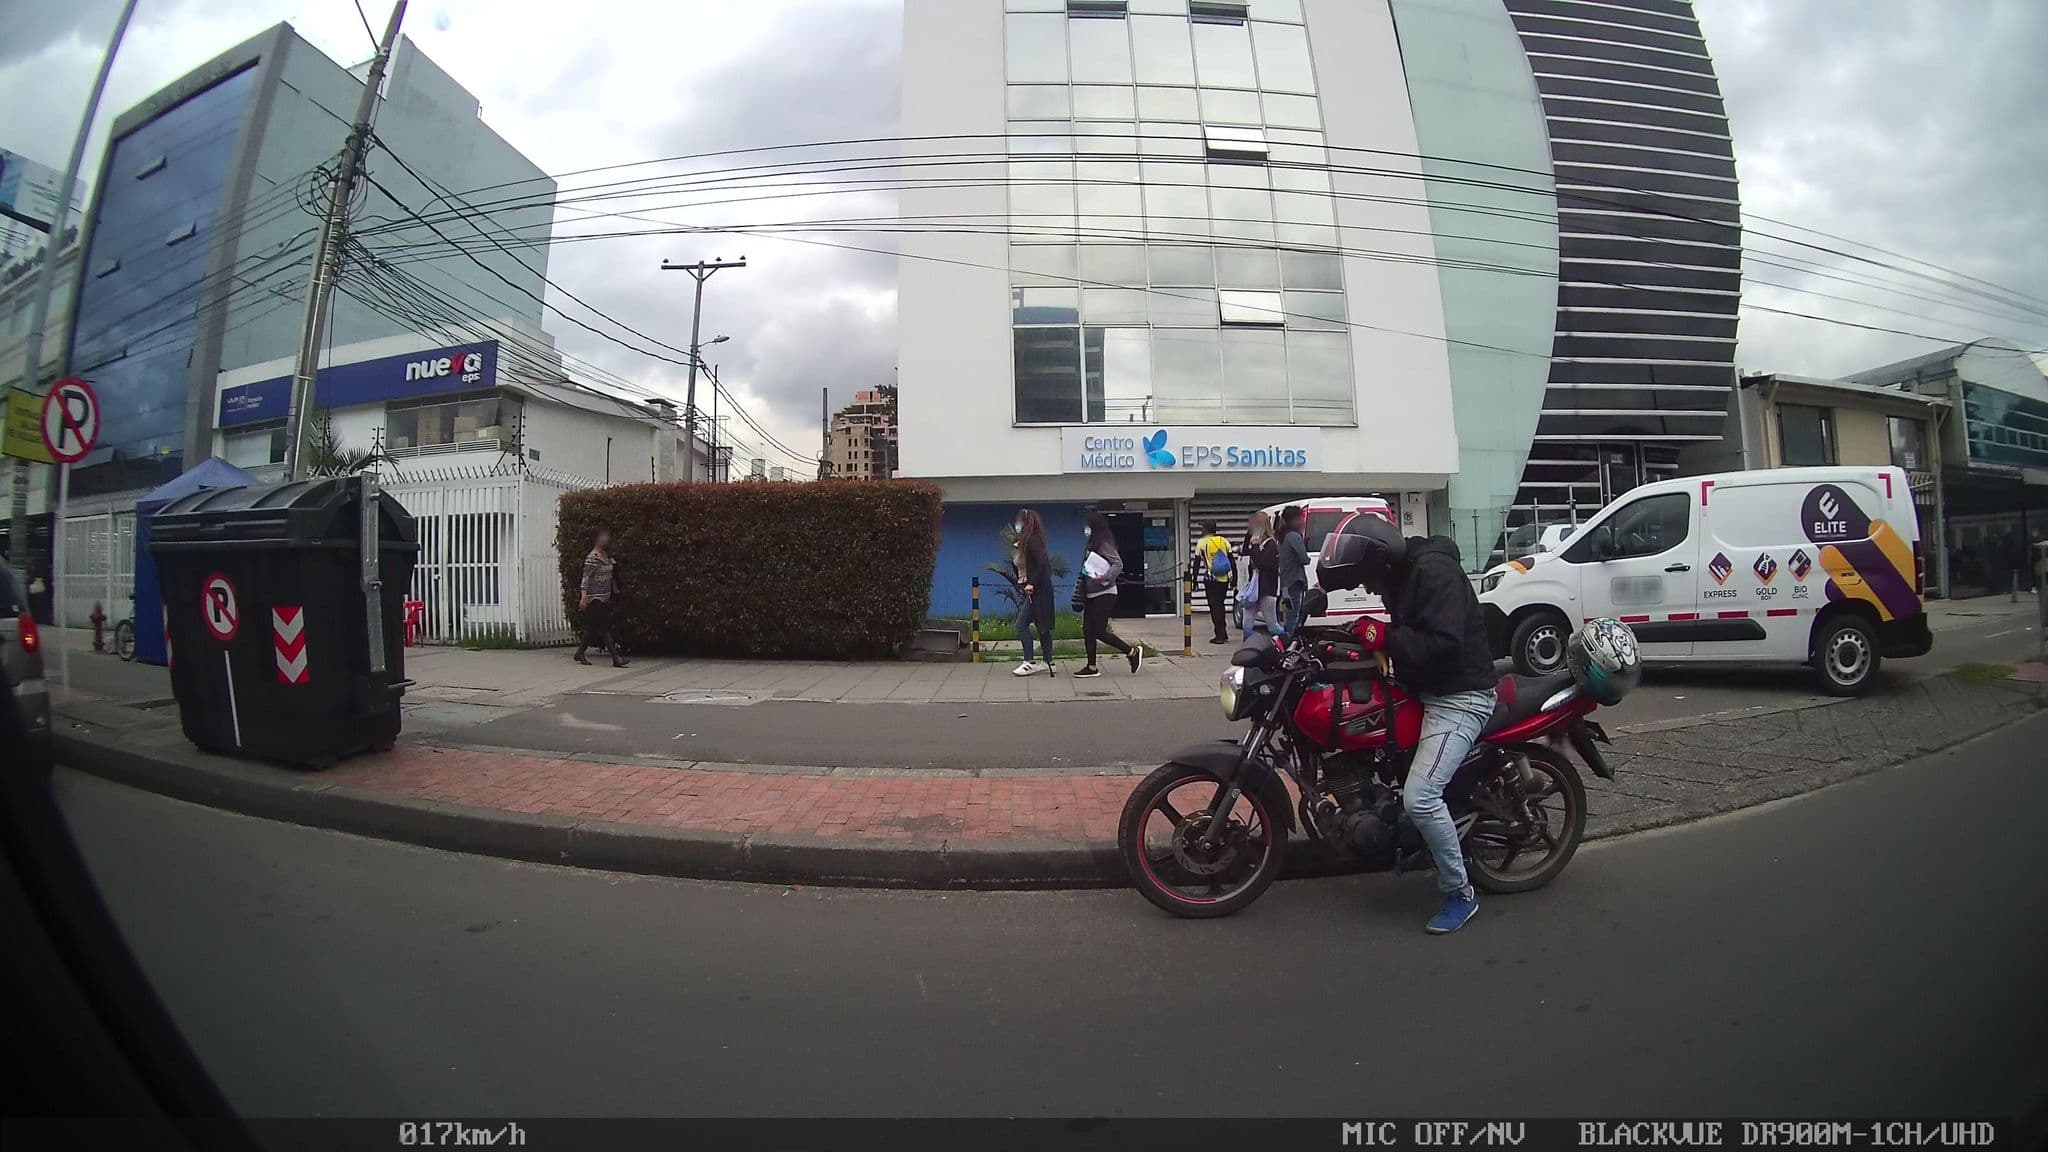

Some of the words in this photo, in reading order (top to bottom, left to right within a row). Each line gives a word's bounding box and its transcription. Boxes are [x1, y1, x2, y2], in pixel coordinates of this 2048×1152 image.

[406, 352, 482, 381] nueva
[462, 372, 481, 384] eps
[1084, 436, 1134, 451] Centro
[1081, 452, 1135, 469] Médico
[1181, 445, 1223, 468] EPS
[1226, 444, 1307, 468] Sanitas
[1814, 520, 1847, 535] ELITE
[1703, 589, 1737, 599] EXPRESS
[1755, 587, 1778, 596] GOLD
[1793, 585, 1808, 594] BIO
